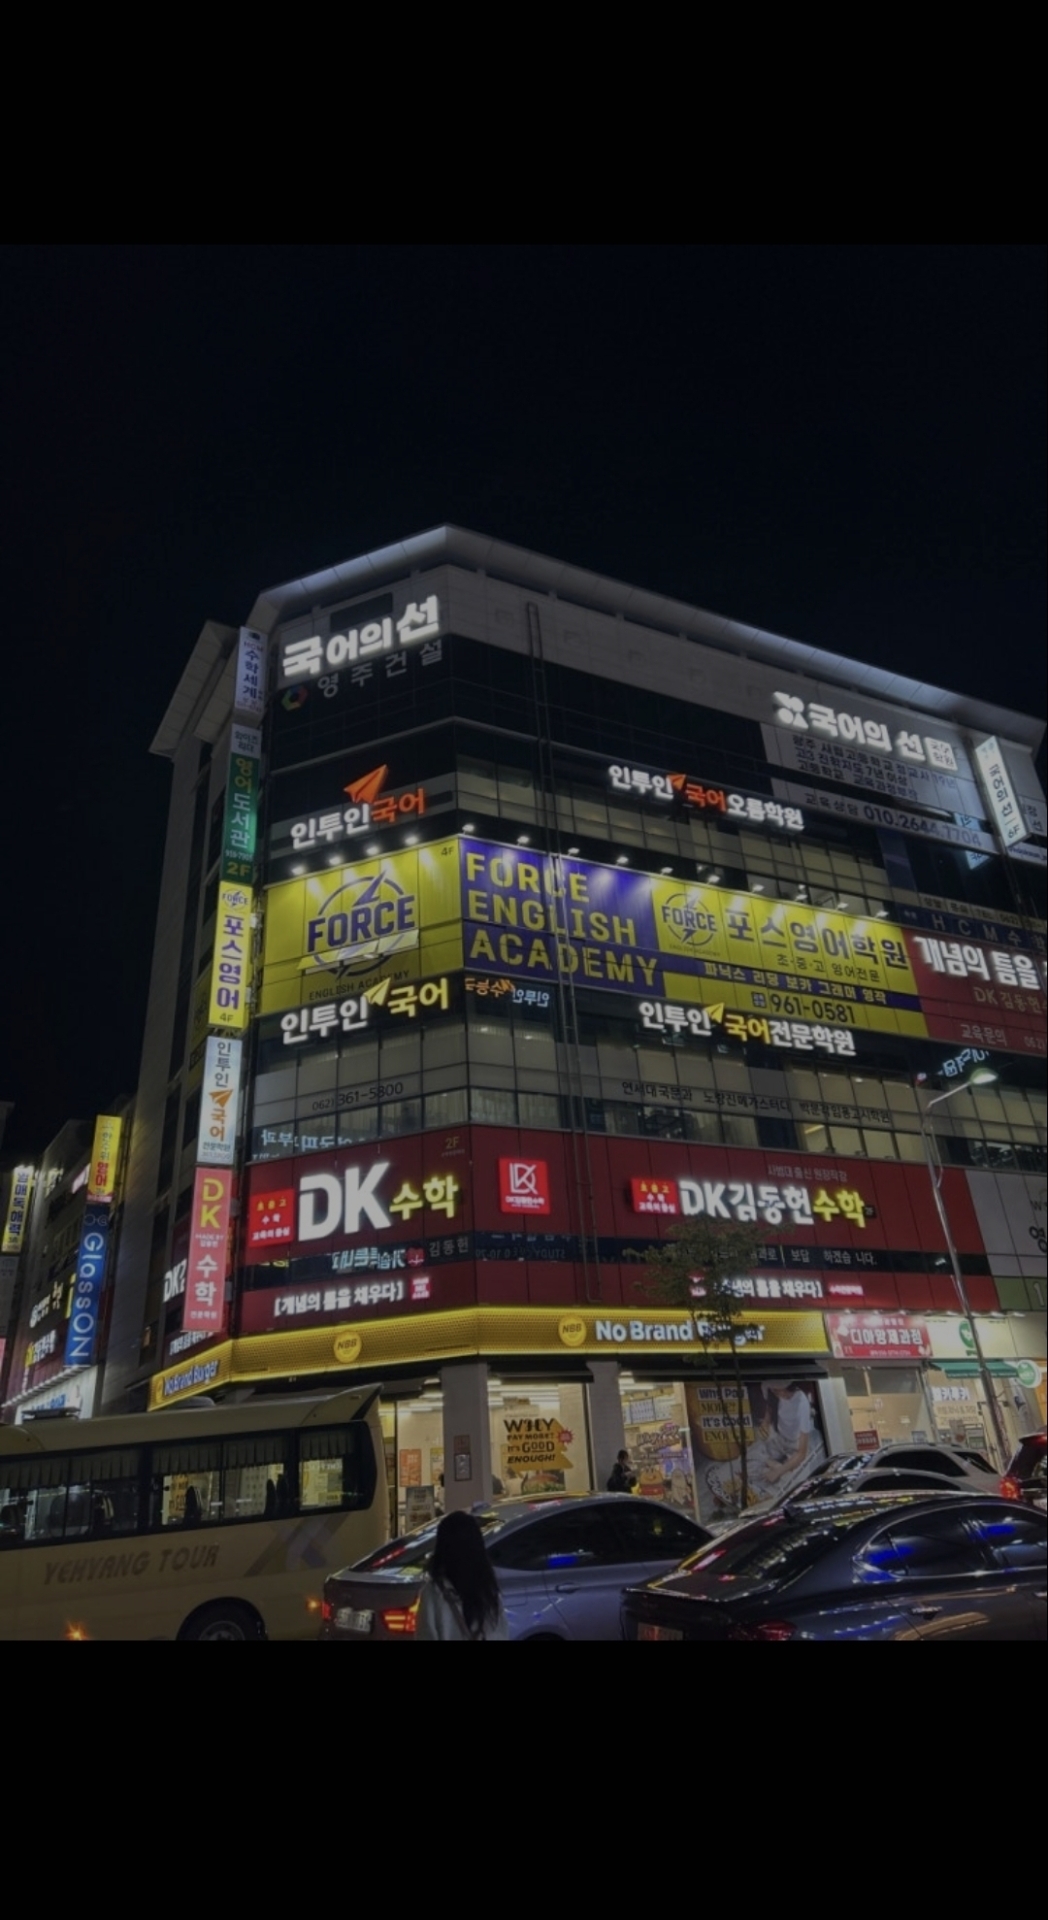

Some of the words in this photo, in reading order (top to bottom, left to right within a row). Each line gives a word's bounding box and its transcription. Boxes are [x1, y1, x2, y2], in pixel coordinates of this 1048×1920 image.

[608, 764, 674, 800] 인투인
[290, 803, 370, 849] 인투인
[372, 787, 426, 823] 국어
[226, 862, 251, 877] 2F
[466, 852, 590, 903] FORCE
[222, 891, 249, 905] FORCE
[308, 895, 416, 952] FORCE
[468, 889, 637, 947] ENGLISH
[661, 905, 717, 932] FORCE
[725, 907, 909, 971] 포스영어학원
[216, 915, 245, 1009] 포스영어
[469, 928, 658, 987] ACADEMY
[913, 935, 991, 981] 개념의
[990, 950, 1041, 991] 틀을
[309, 984, 354, 1001] ENGLISH
[753, 970, 780, 988] 리딩
[785, 975, 813, 993] 보카
[219, 1012, 234, 1023] 4F
[280, 996, 368, 1044] 인투인
[387, 977, 449, 1018] 국어
[639, 1001, 712, 1037] 인투인
[769, 993, 856, 1024] 961-0581
[215, 1042, 231, 1088] 인투인
[338, 1082, 404, 1107] 361-5800
[209, 1109, 228, 1142] 국어
[194, 1254, 219, 1306] 수학
[596, 1320, 627, 1343] No
[630, 1319, 693, 1342] Brand
[522, 1440, 555, 1454] GOOD
[159, 1544, 220, 1573] TOUR
